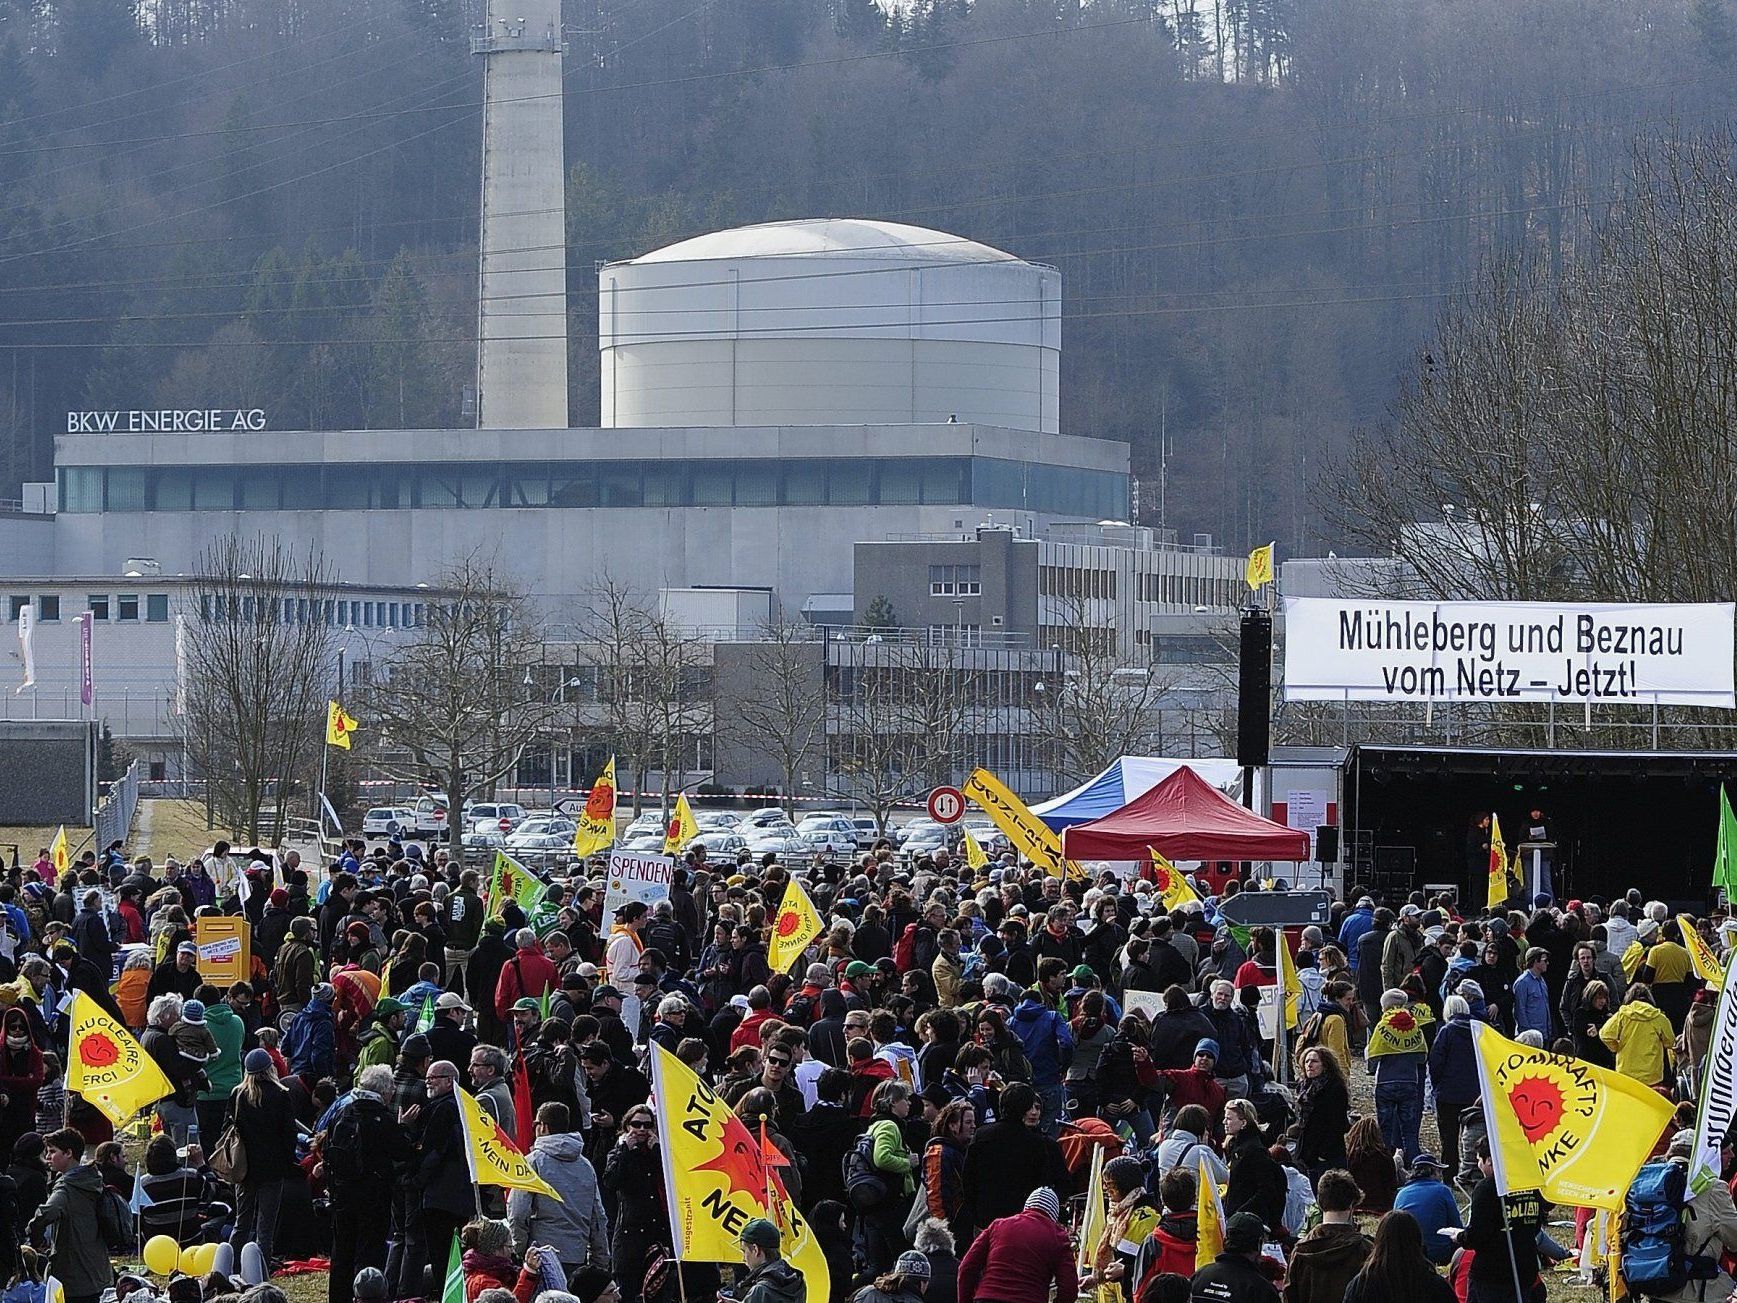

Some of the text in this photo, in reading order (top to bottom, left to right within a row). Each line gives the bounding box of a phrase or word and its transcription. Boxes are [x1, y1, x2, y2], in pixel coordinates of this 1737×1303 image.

[68, 409, 266, 432] BKW ENERGIE AG
[1339, 609, 1684, 661] Mühleberg und Beznau
[1382, 665, 1445, 696] vom
[1457, 658, 1521, 697] Netz
[1557, 658, 1638, 697] Jetzt!
[611, 856, 672, 884] SPENDEN
[1409, 1006, 1425, 1017] EIN
[1379, 1026, 1422, 1048] NEIN DAN
[480, 1141, 509, 1172] NEIN
